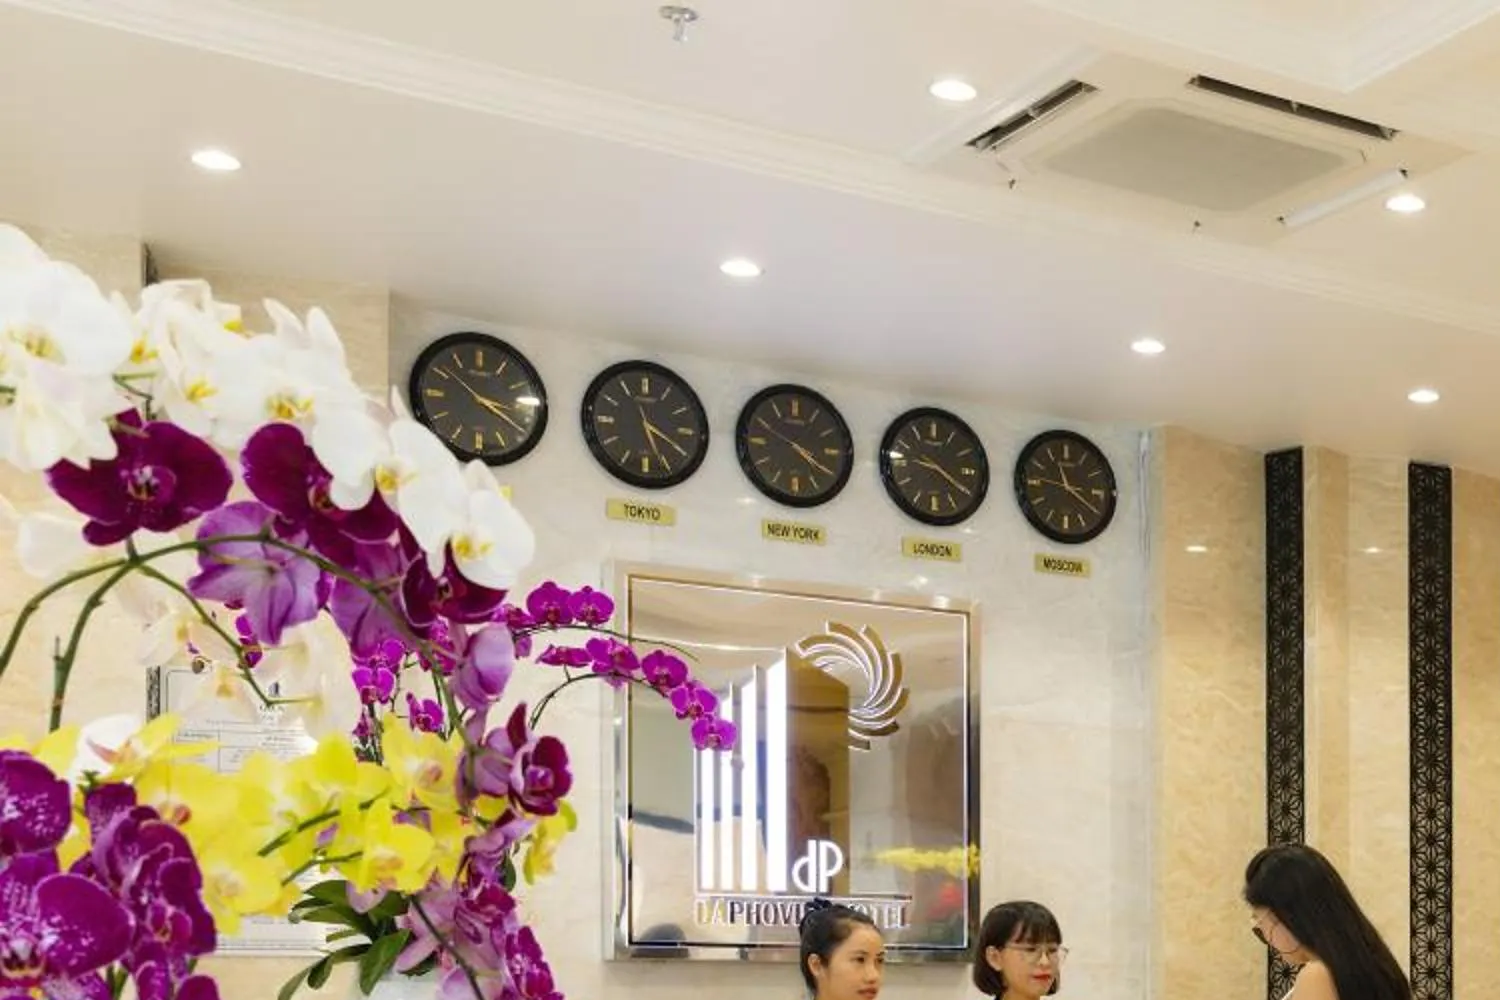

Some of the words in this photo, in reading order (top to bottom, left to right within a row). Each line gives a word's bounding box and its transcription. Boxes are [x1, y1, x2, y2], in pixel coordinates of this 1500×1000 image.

[624, 504, 661, 520] TOKYO
[767, 523, 790, 537] NEW
[791, 525, 819, 540] YORK
[913, 543, 952, 557] LONDON
[1043, 557, 1083, 573] MOSCOW
[695, 898, 806, 927] DAPHOVI
